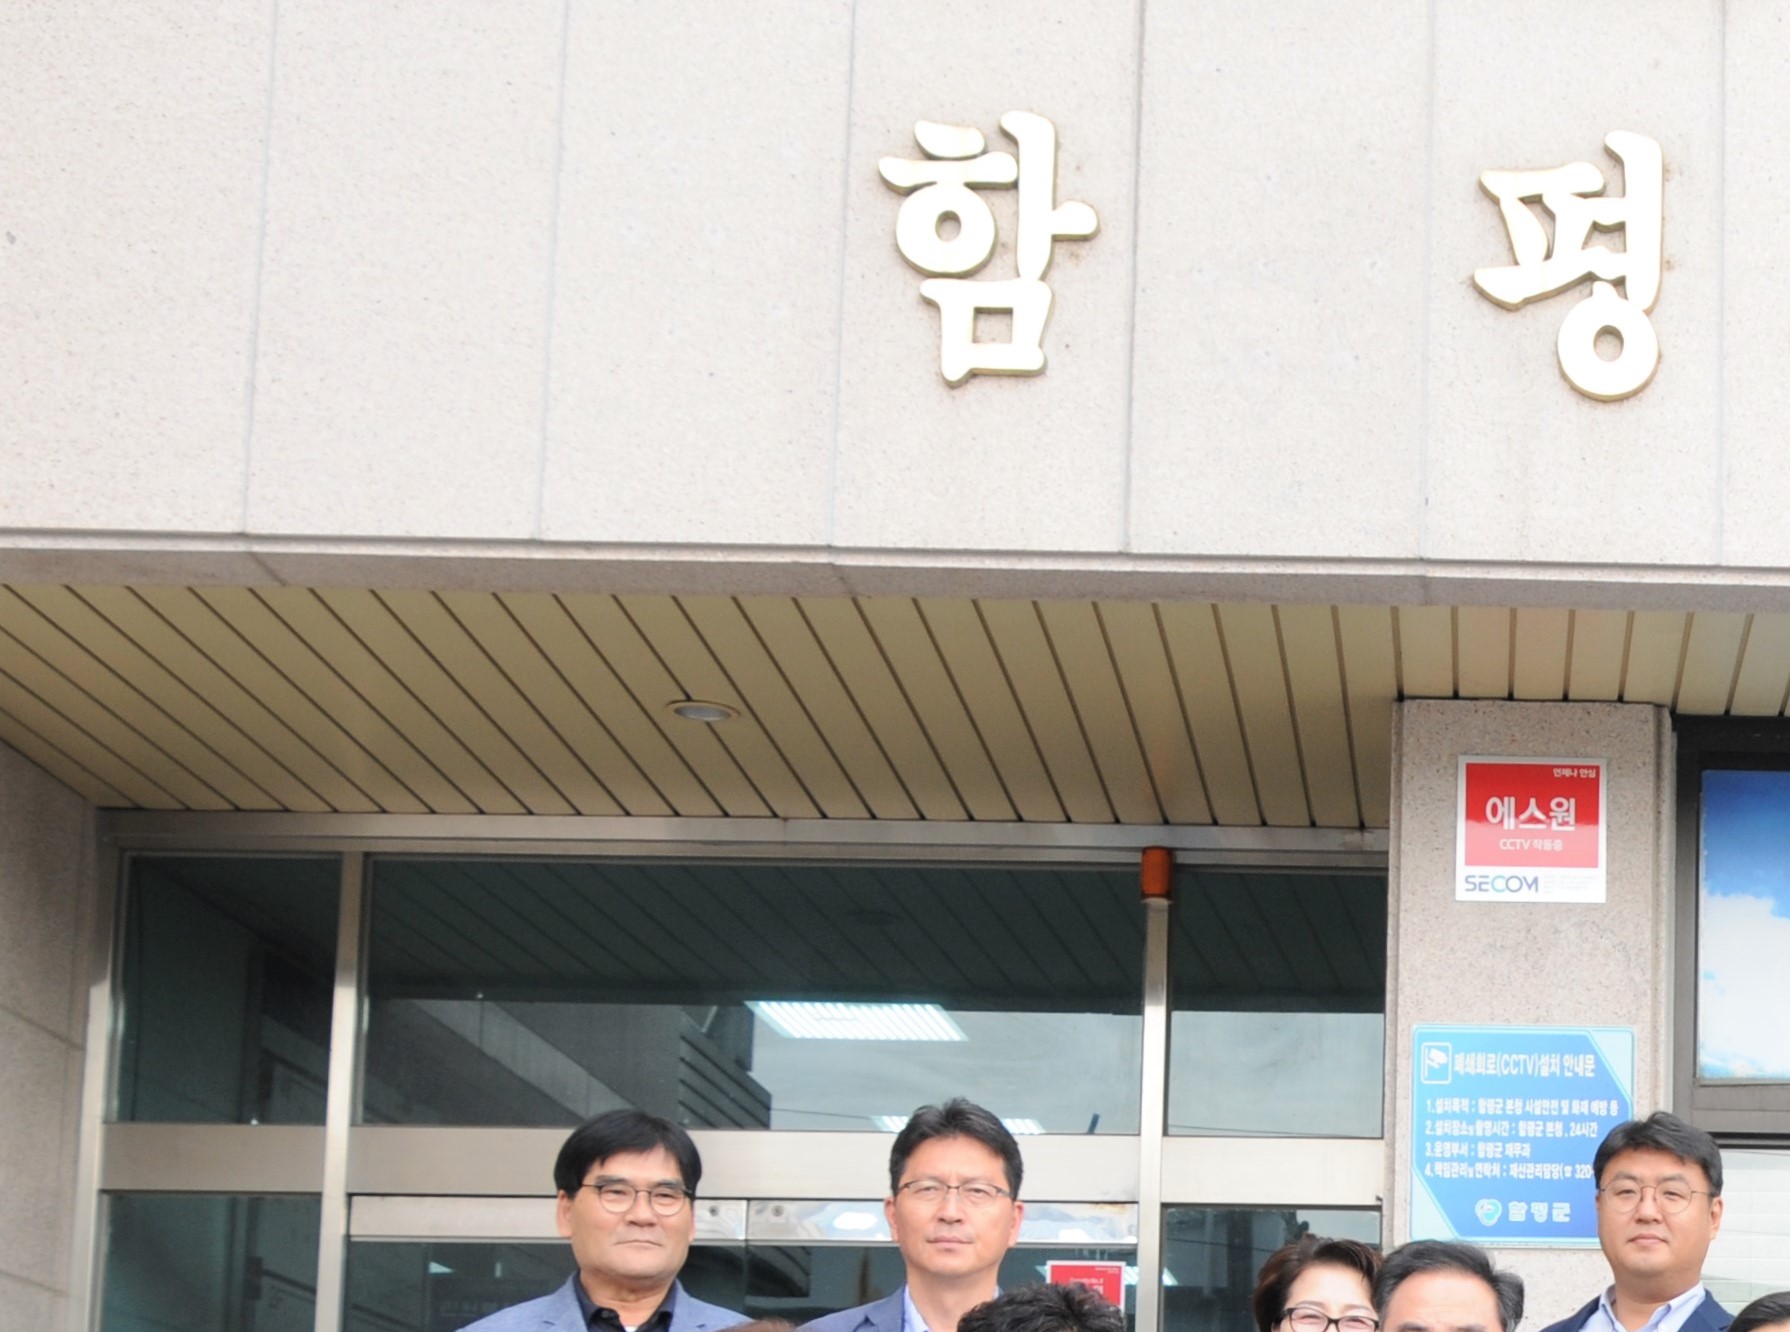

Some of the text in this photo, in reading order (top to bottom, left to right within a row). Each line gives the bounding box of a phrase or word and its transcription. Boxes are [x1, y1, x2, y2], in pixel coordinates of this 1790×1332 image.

[1485, 796, 1577, 832] 에스원
[1499, 838, 1531, 851] CCTV
[1464, 874, 1539, 894] SECOM
[1563, 1054, 1596, 1078] 안내문
[1478, 1098, 1503, 1115] 함평군
[1518, 1121, 1544, 1138] 함평군
[1477, 1142, 1503, 1159] 함평군
[1507, 1201, 1571, 1223] 함평군
